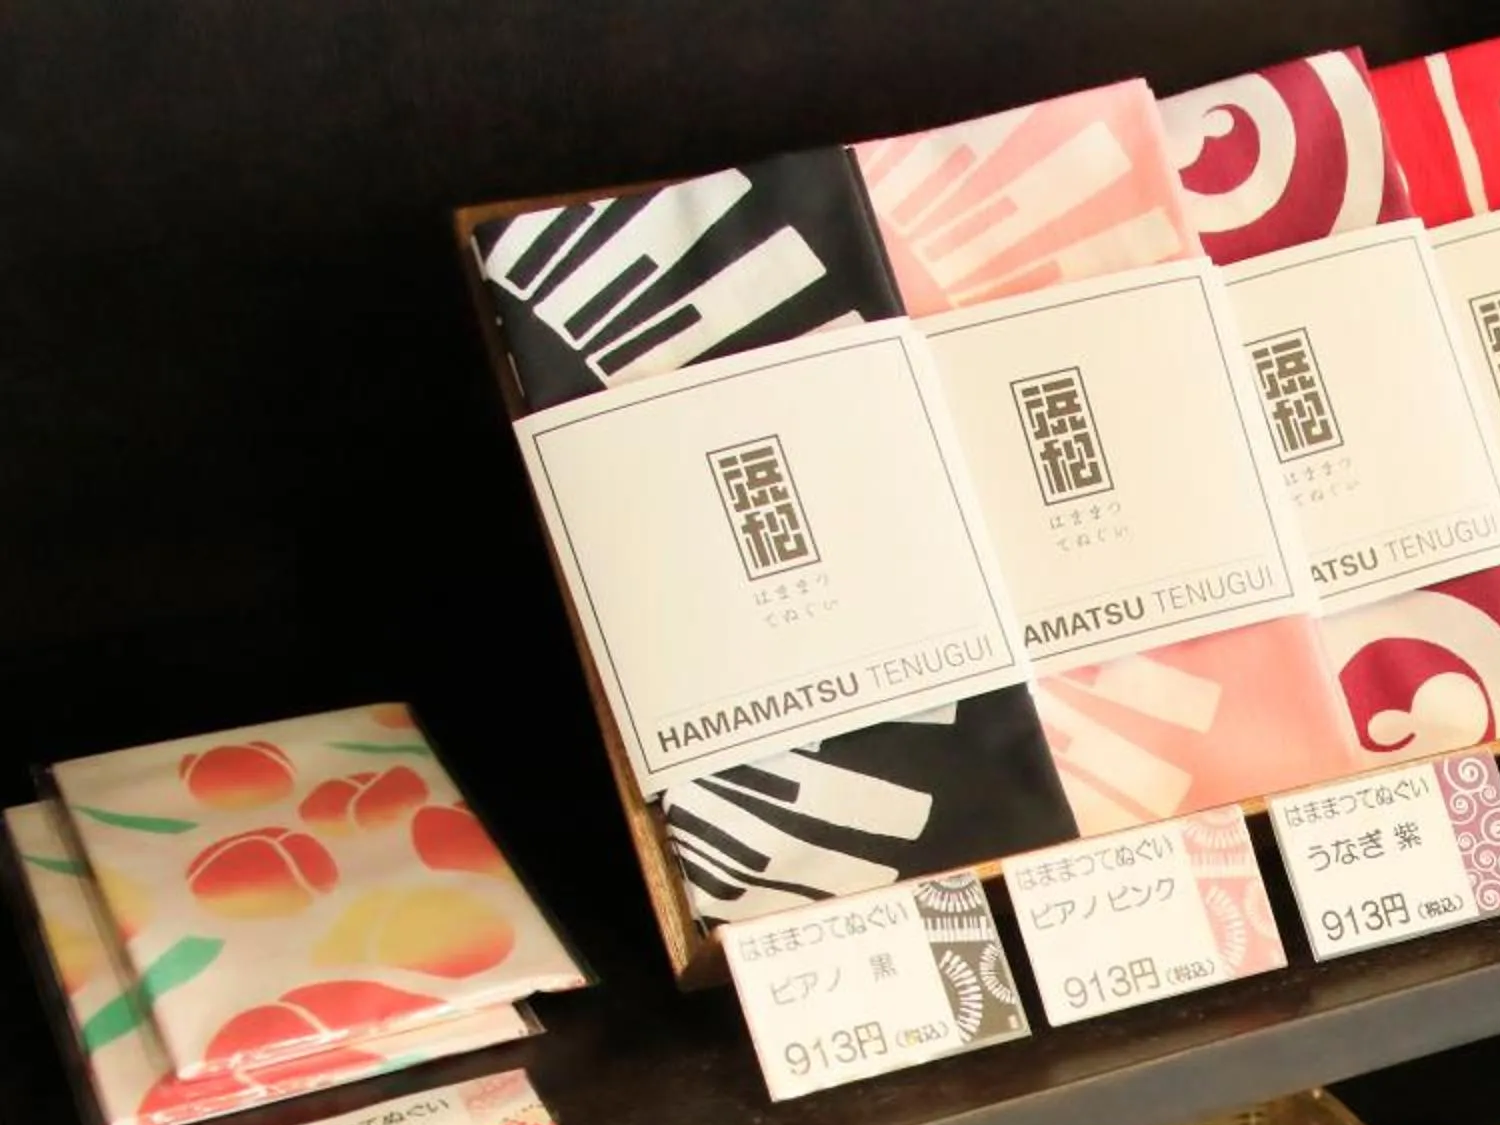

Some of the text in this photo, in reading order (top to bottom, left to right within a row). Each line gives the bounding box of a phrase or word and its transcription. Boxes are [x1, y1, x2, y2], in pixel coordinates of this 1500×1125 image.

[1385, 513, 1499, 563] TENUGUI
[1153, 564, 1275, 614] TENUGUI
[657, 634, 995, 753] HAMAMATSU TENUGUI
[1284, 777, 1431, 828] はままつてぬぐい
[1015, 833, 1175, 892] はままつてぬぐい
[1307, 820, 1424, 872] うなぎ 紫
[738, 902, 909, 962] はままつてぬぐい
[1321, 892, 1412, 942] 913円
[770, 952, 899, 1006] ピアノ 黒
[1063, 957, 1163, 1009] 913円
[783, 1020, 889, 1076] 913円
